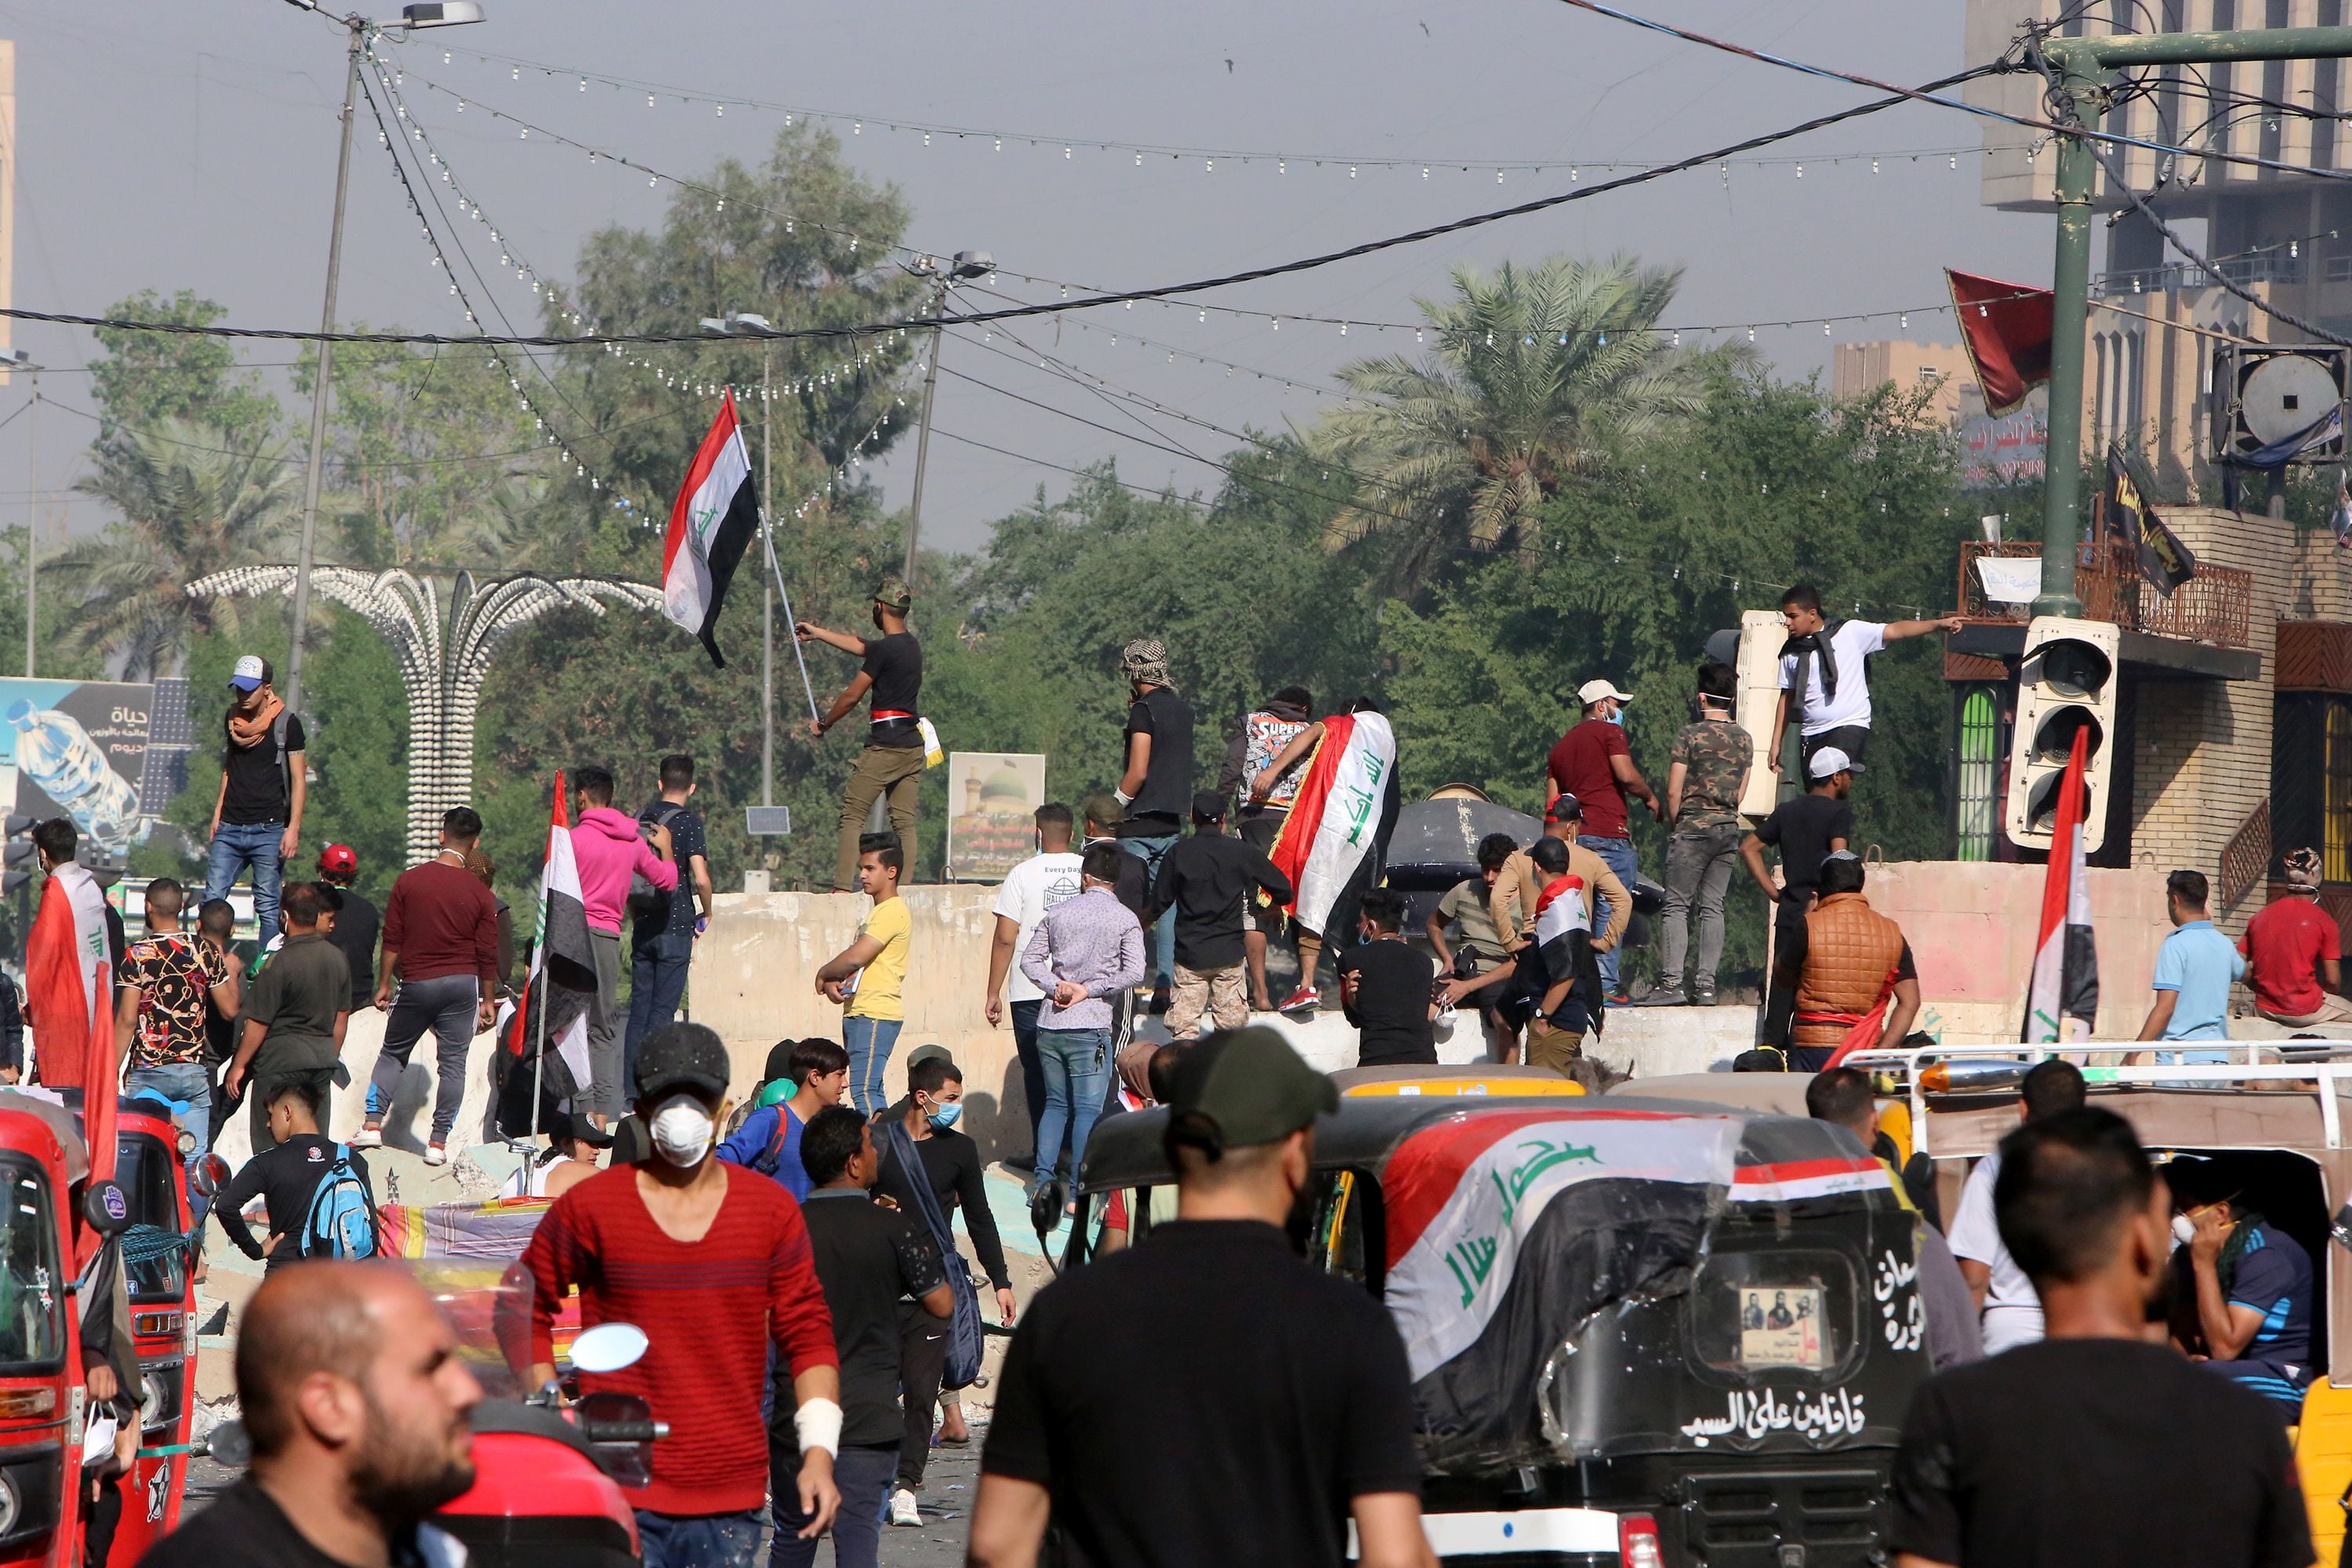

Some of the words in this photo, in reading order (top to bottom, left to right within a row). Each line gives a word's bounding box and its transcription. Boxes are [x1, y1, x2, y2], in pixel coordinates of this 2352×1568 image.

[111, 706, 148, 727] حياة
[1258, 721, 1305, 740] SUPER
[1361, 748, 1385, 786] الله
[1046, 893, 1062, 906] HALL
